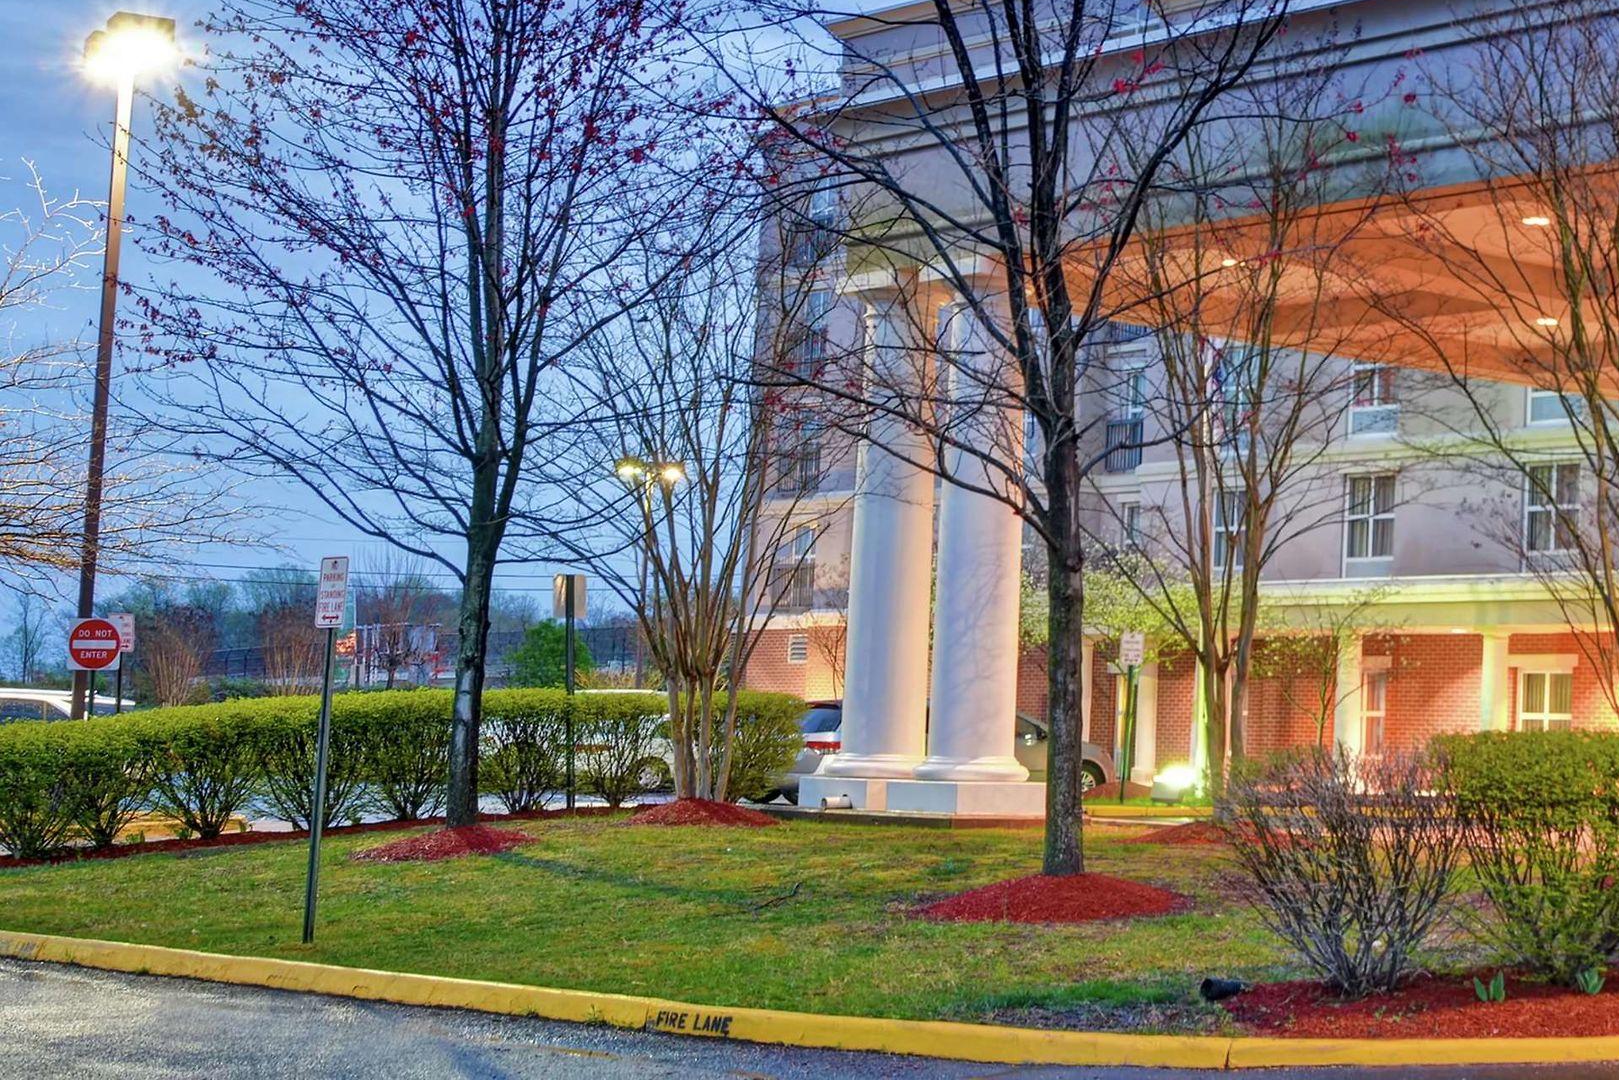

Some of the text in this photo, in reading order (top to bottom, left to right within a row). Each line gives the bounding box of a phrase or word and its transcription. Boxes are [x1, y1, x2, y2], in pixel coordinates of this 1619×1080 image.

[78, 629, 113, 638] DO NOT
[80, 650, 108, 659] ENTER
[656, 1009, 734, 1035] FIRE LANE
